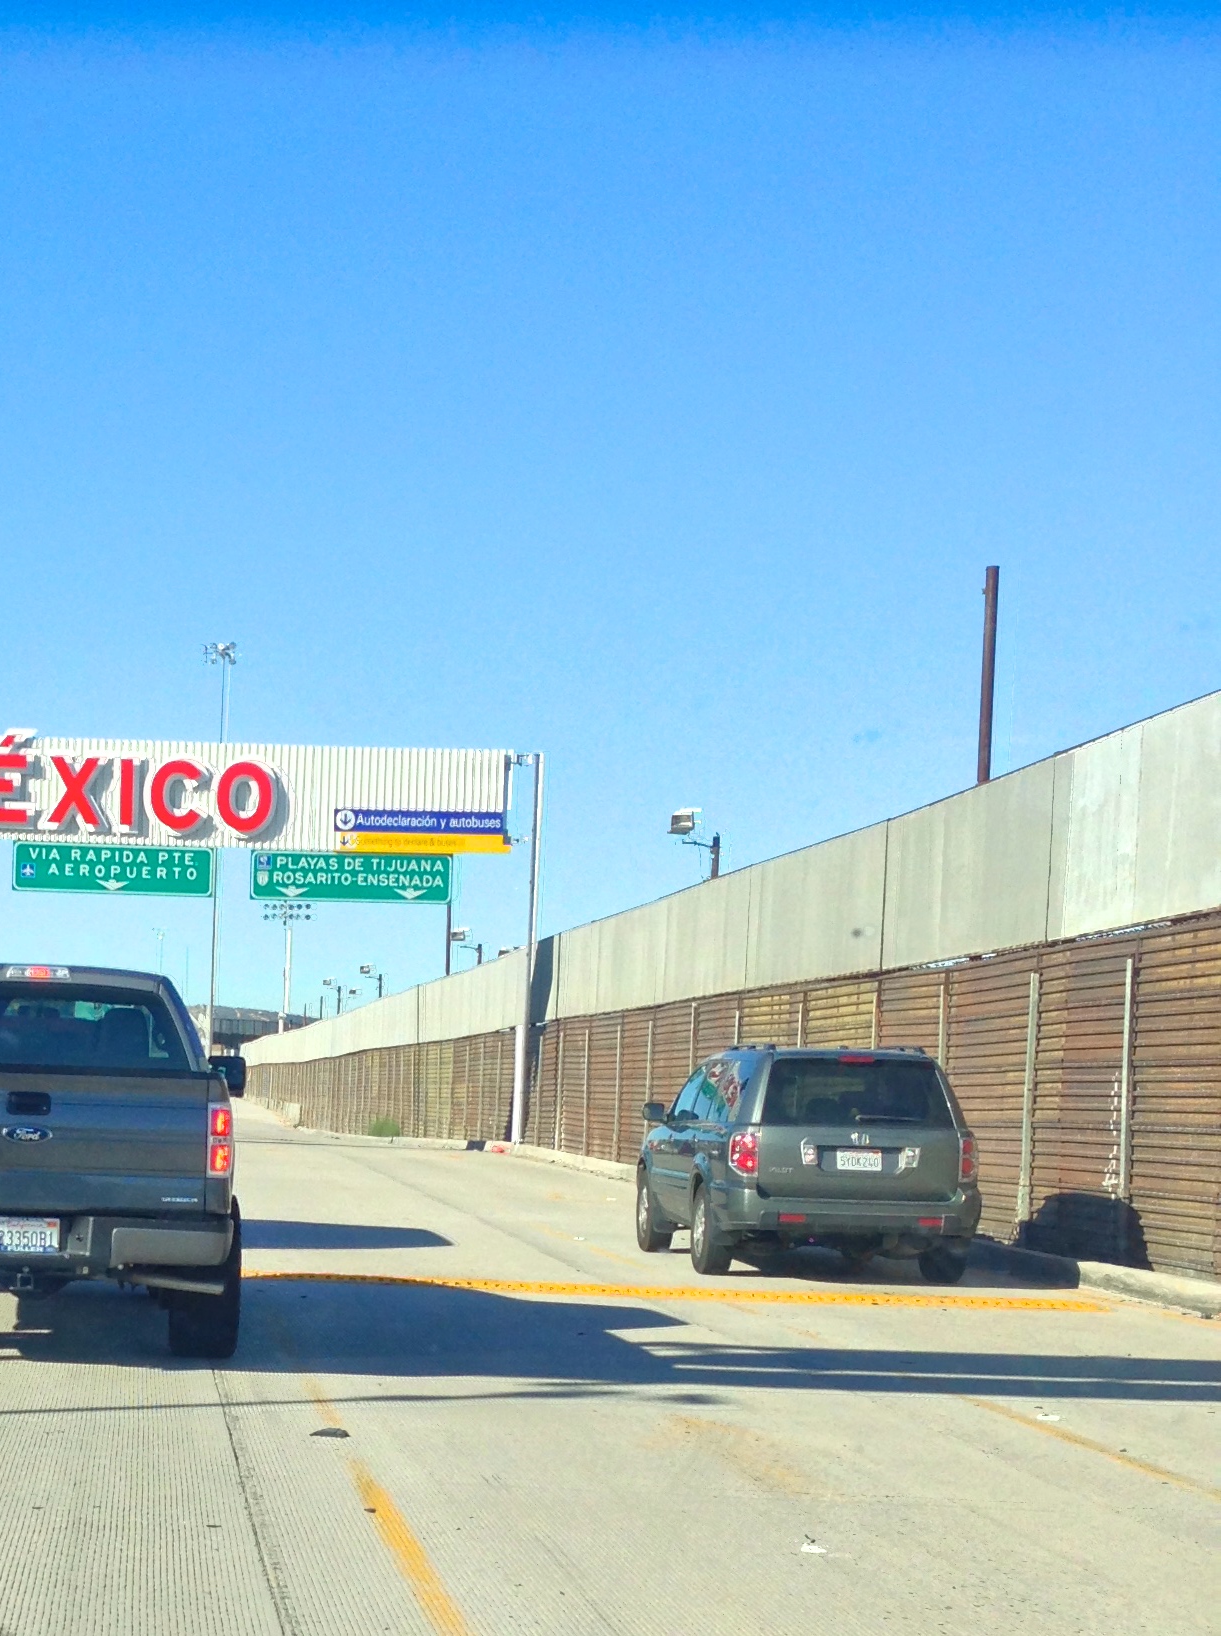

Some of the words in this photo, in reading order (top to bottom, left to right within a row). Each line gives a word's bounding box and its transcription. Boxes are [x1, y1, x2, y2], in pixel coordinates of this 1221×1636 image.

[356, 814, 437, 827] Autodeclaración
[440, 818, 447, 829] y
[449, 815, 501, 829] autobuses
[29, 847, 60, 861] VIA
[71, 848, 148, 864] RAPIDA
[48, 863, 197, 881] AEROPUERTO
[276, 856, 338, 870] PLAYAS
[344, 858, 364, 871] DE
[371, 858, 444, 872] TIJUANA
[273, 872, 444, 888] ROSARITO-ENSENADA
[13, 1127, 41, 1140] Ford
